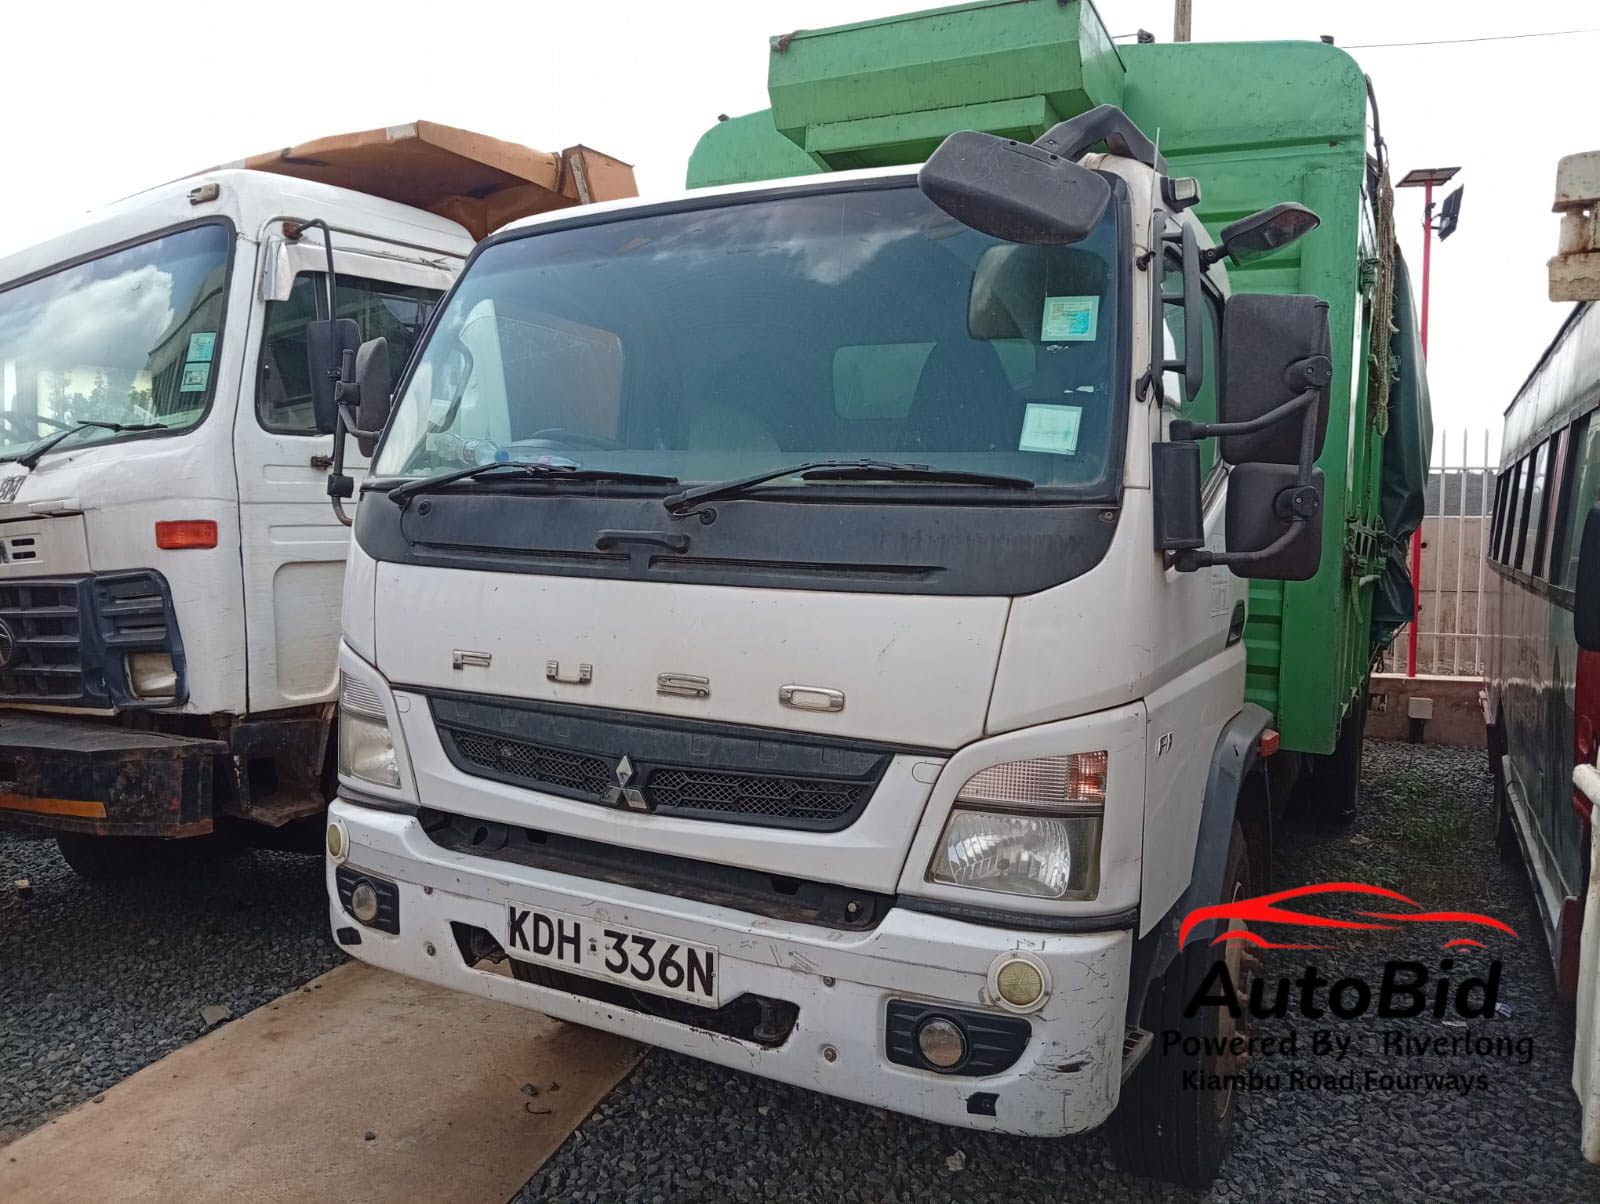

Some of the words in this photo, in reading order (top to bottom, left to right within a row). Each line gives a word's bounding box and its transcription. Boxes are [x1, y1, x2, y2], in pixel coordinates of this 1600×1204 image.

[452, 648, 845, 712] FUSO
[508, 906, 581, 964] KDH
[603, 929, 714, 997] 336N
